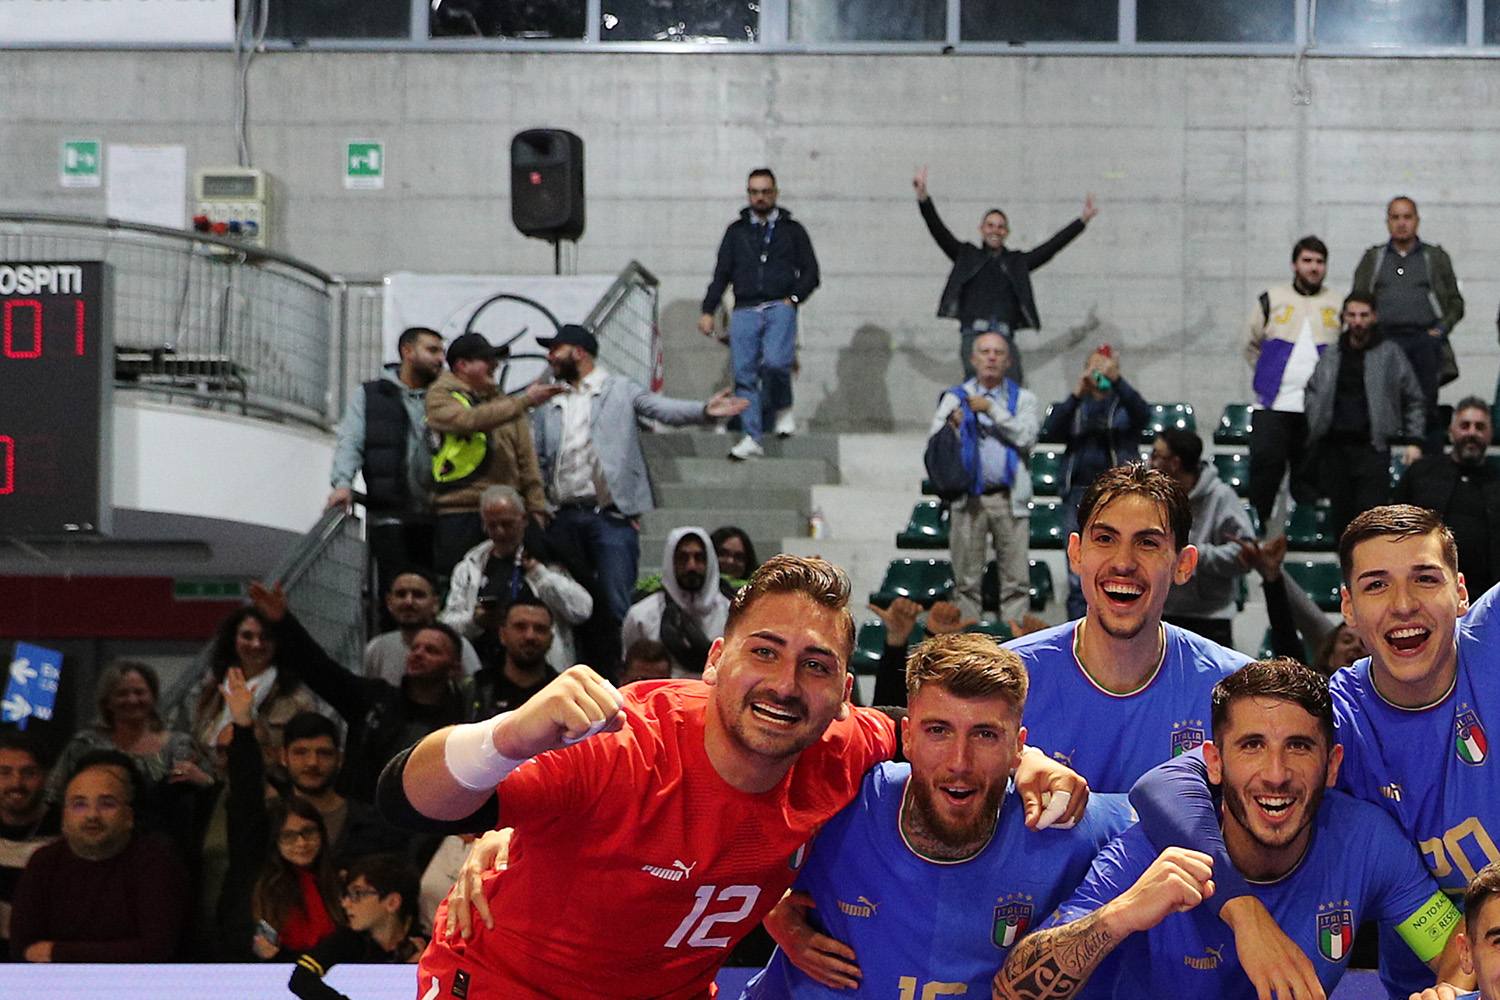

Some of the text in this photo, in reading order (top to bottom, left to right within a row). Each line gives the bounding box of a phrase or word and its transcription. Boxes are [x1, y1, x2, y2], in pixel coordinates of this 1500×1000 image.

[641, 864, 684, 881] PUMA
[663, 884, 762, 949] 12
[997, 906, 1030, 917] ITALIA
[1412, 915, 1428, 930] NO
[1425, 906, 1438, 918] TO
[1184, 954, 1218, 970] PUMA
